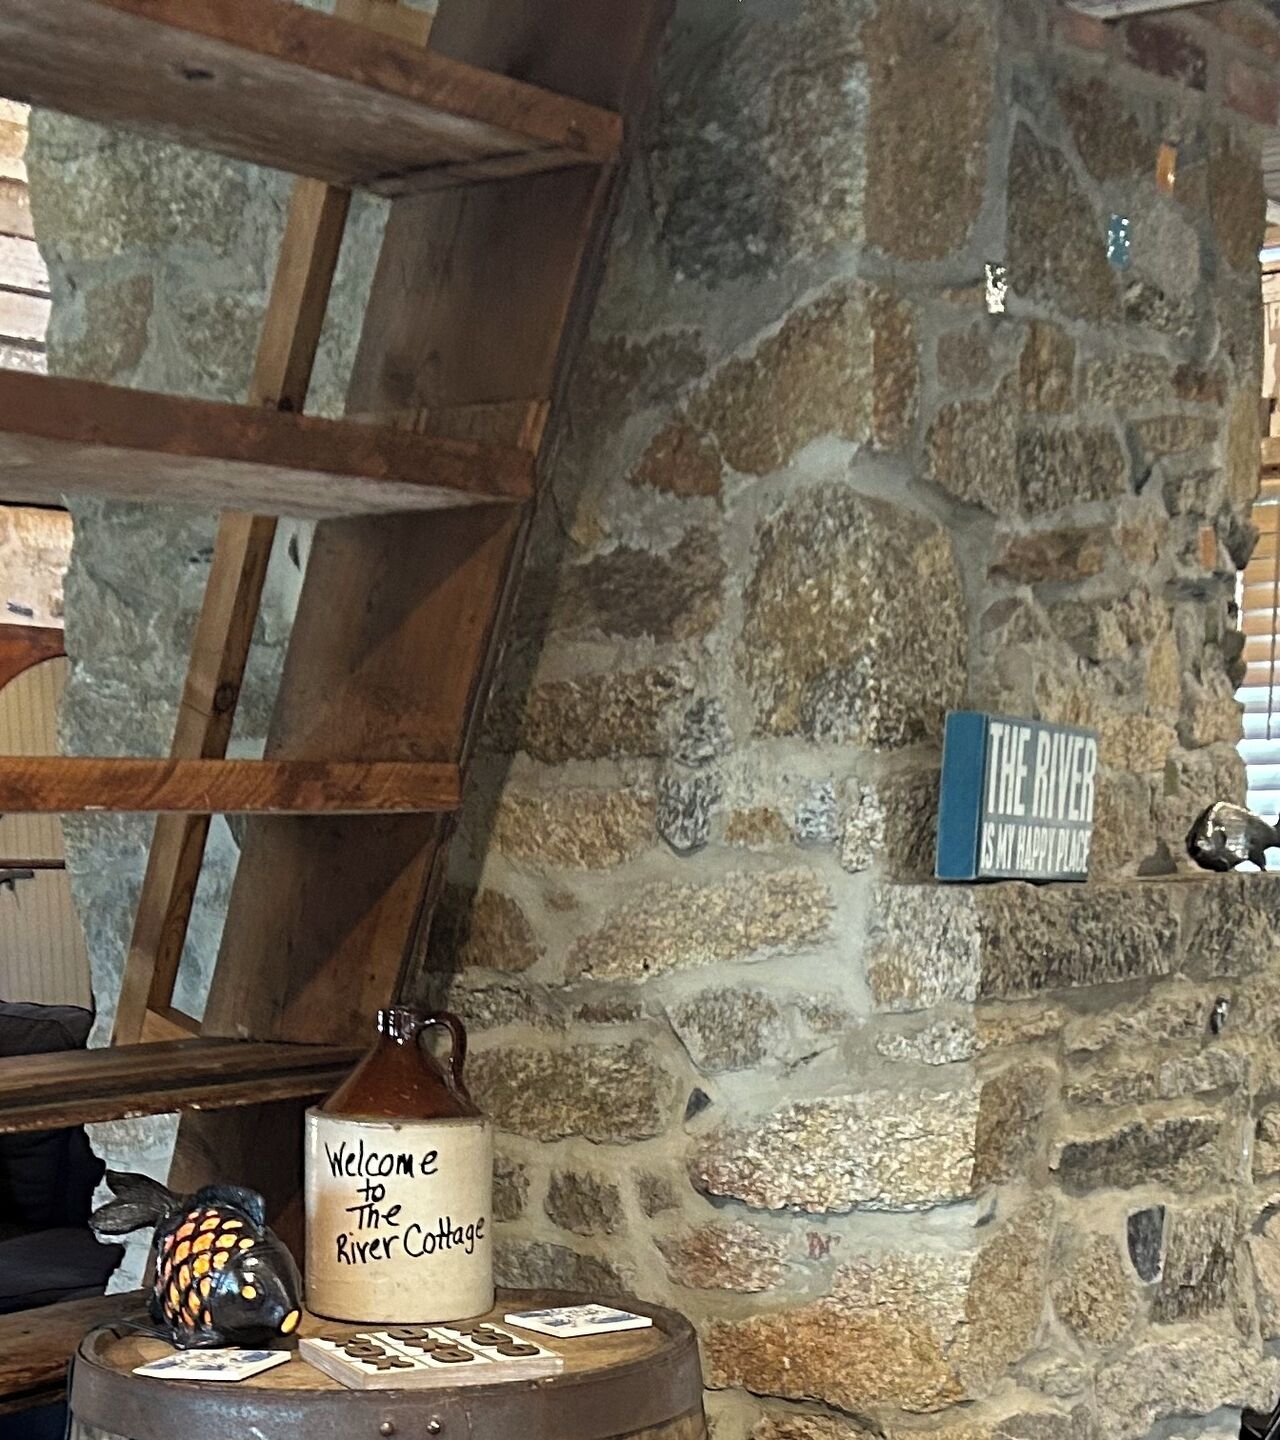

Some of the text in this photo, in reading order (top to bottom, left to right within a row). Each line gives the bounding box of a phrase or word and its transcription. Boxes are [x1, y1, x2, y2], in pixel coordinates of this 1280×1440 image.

[988, 722, 1097, 822] THE RIVER
[980, 822, 1091, 873] IS MY HAPPY PLACE
[324, 1139, 439, 1178] Welcome
[356, 1178, 386, 1202] to
[345, 1203, 402, 1229] The
[336, 1216, 486, 1265] River Cottage
